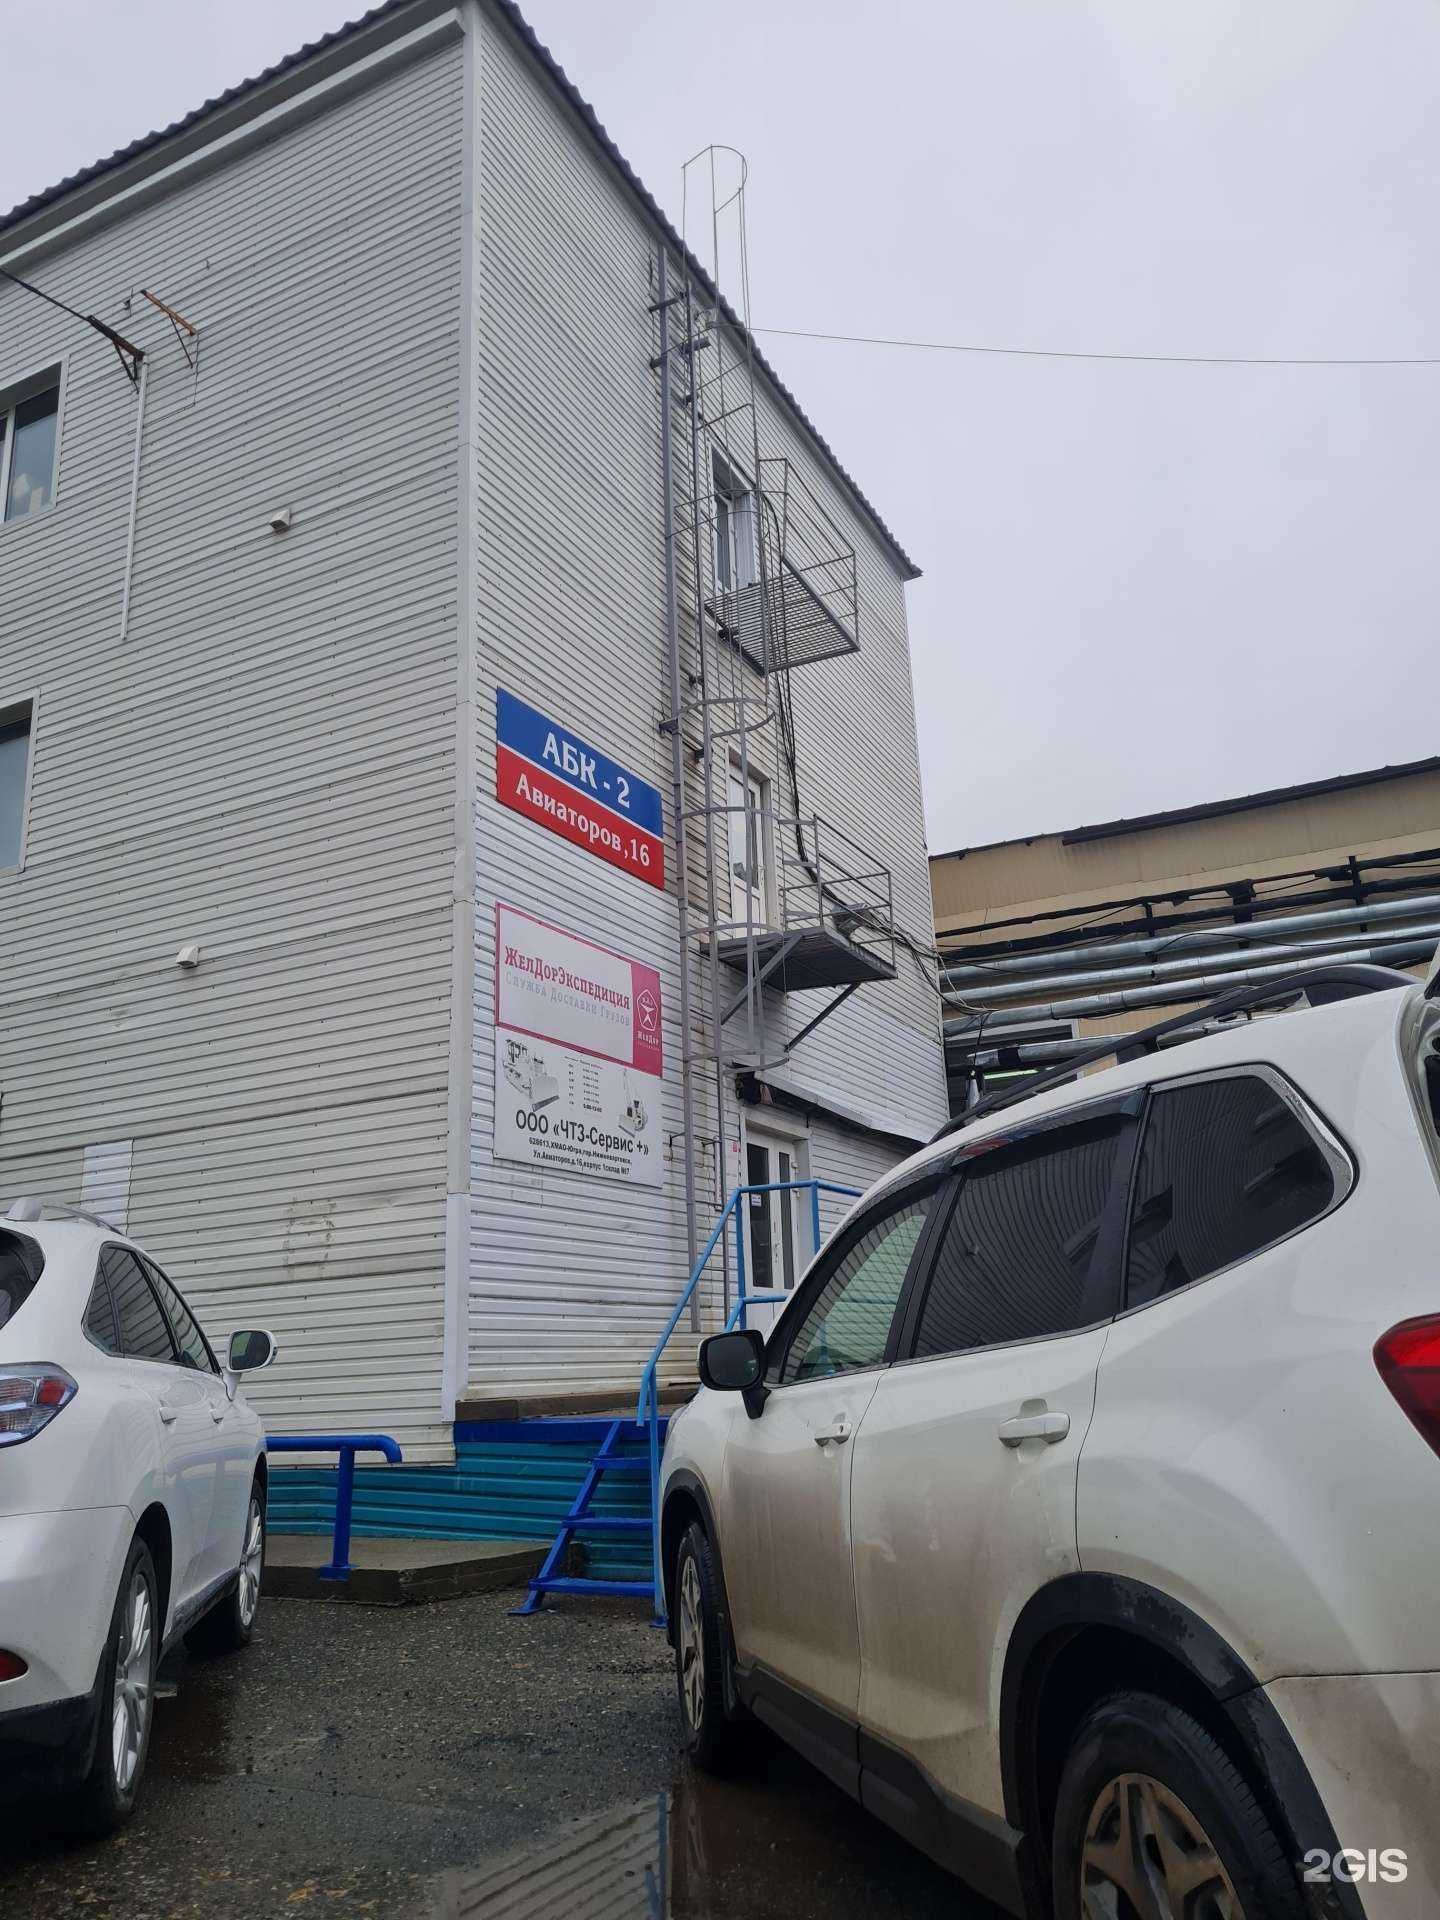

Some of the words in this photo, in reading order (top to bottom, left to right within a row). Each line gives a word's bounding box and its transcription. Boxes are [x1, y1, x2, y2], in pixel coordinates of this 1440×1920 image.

[542, 731, 598, 790] АБК
[616, 776, 630, 808] 2
[516, 1109, 549, 1134] ООО
[553, 1119, 634, 1153] «ЧТЗ-Сервис
